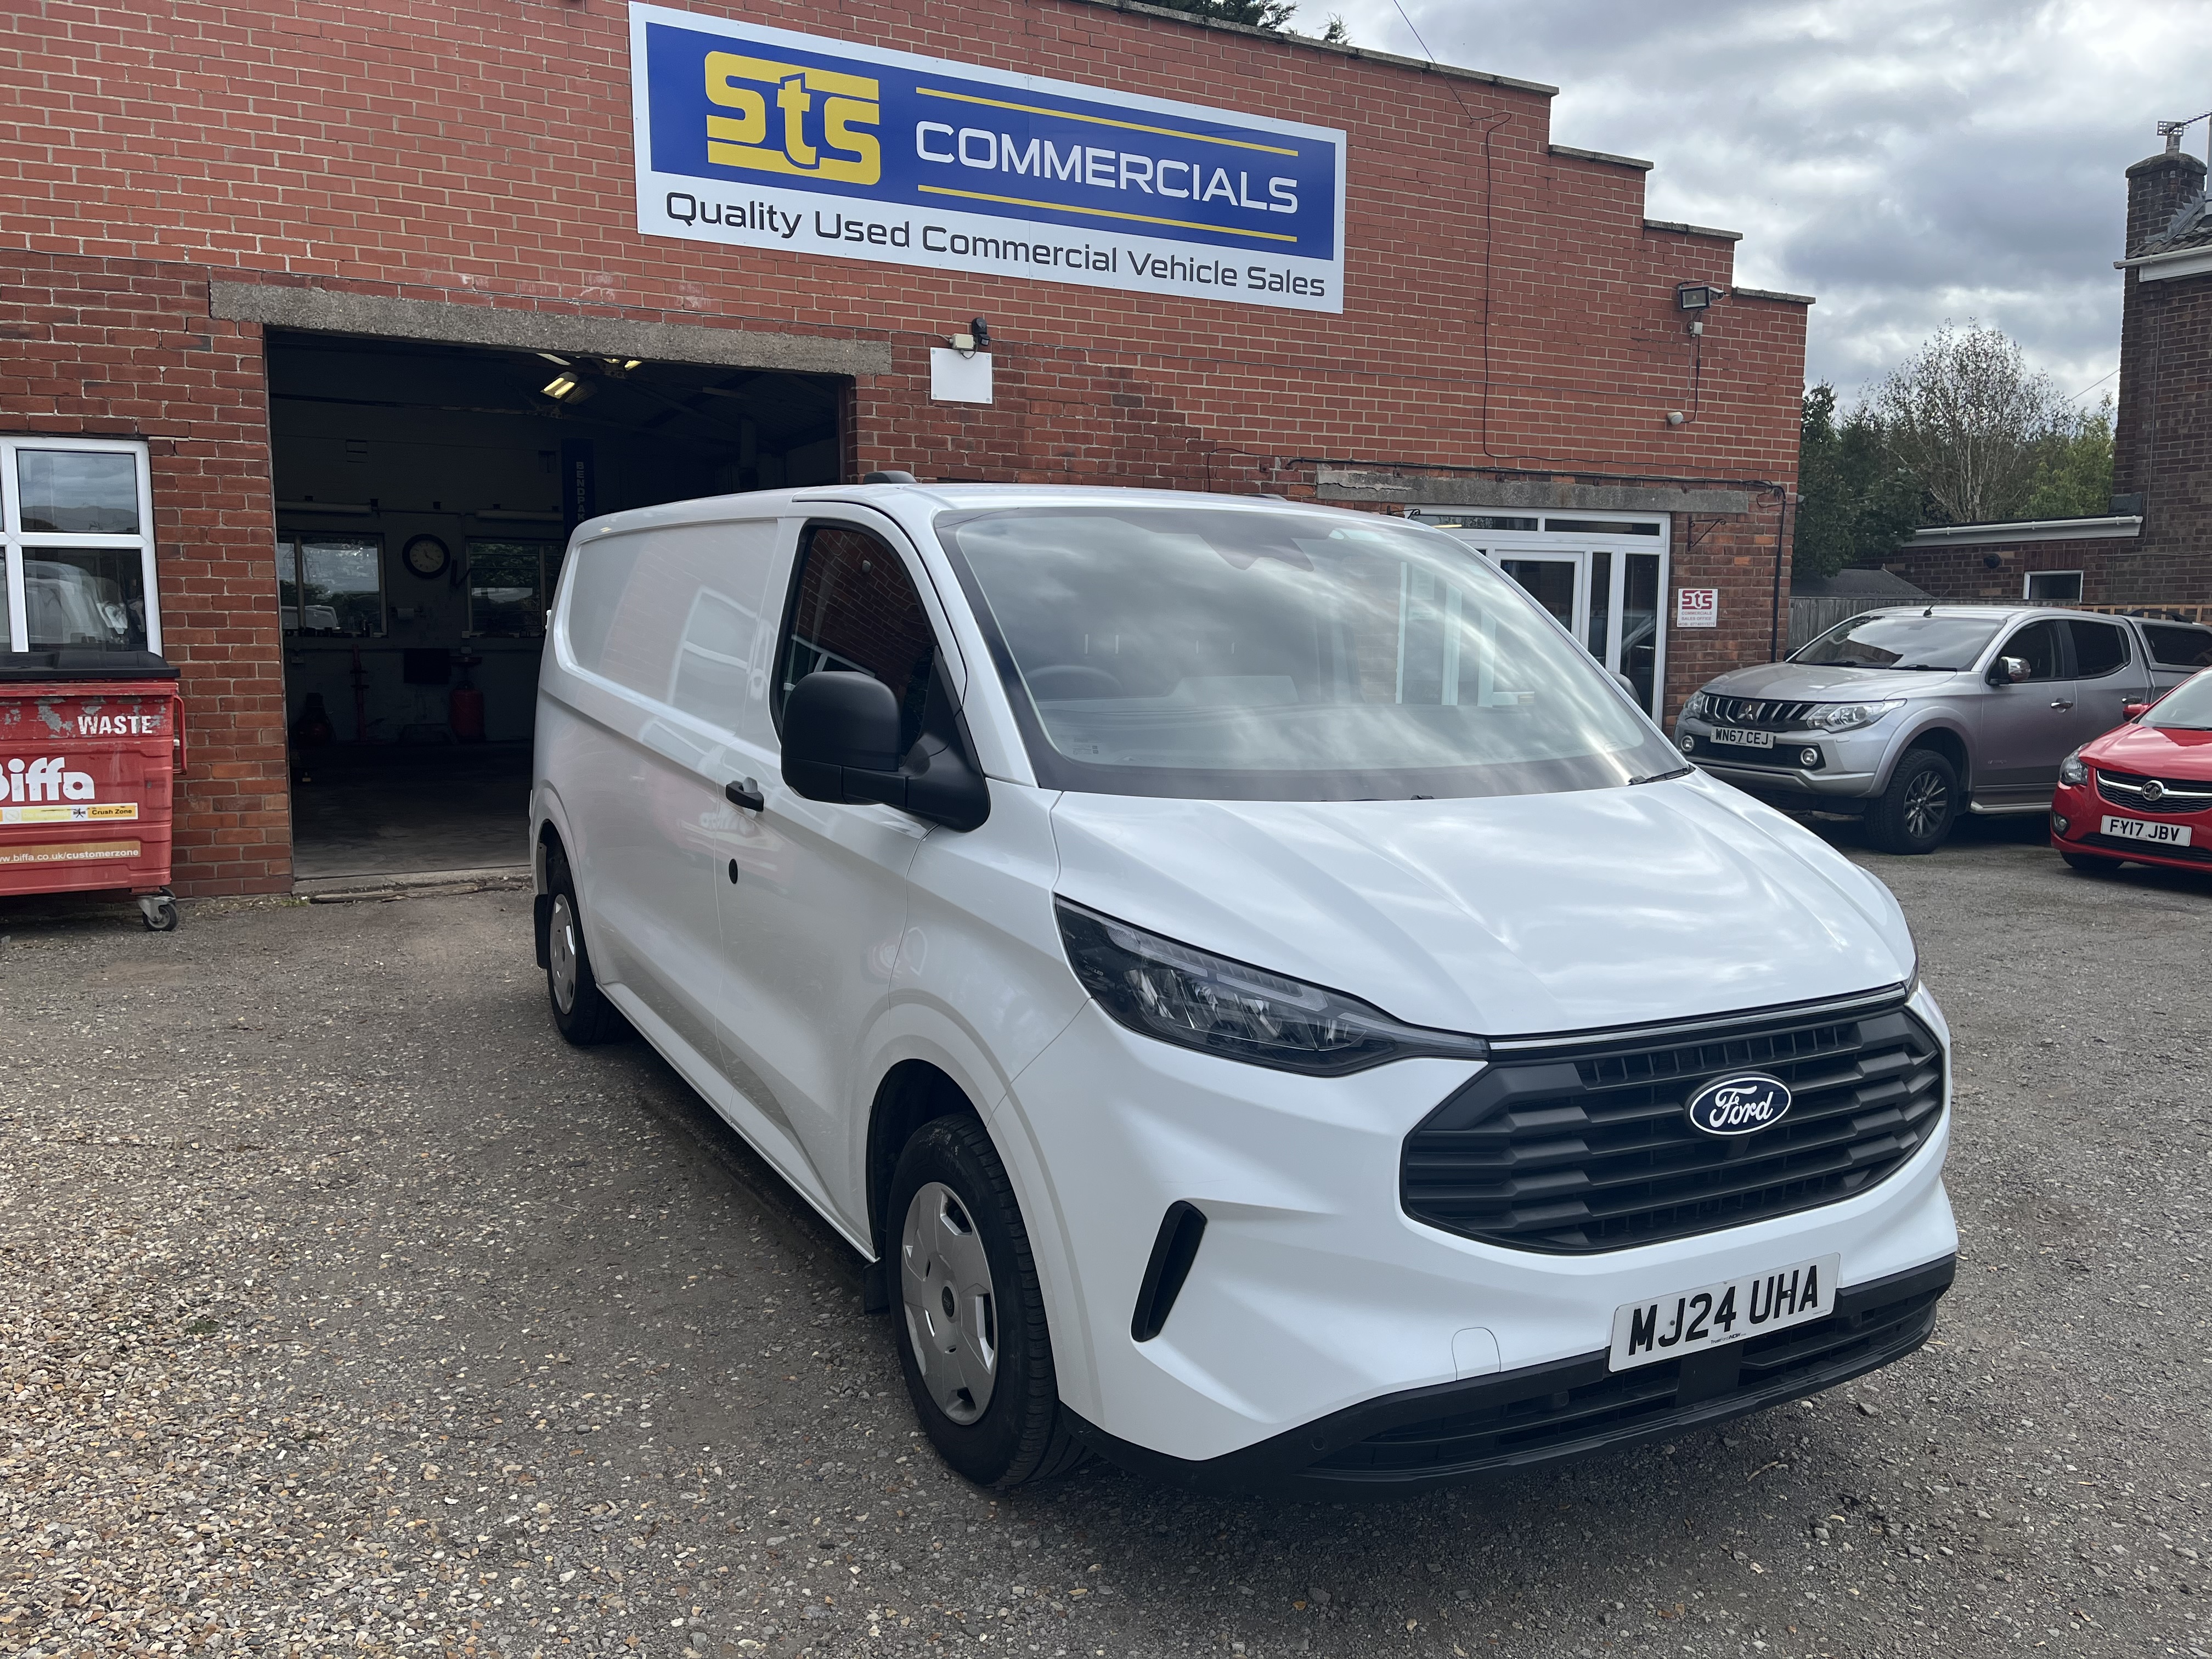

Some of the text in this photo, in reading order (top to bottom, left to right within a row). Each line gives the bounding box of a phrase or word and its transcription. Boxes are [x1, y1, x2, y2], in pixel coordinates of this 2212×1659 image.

[916, 121, 1298, 214] COMMERCIALS
[667, 192, 1325, 297] Quality Used Commercial Vehicle Sales
[576, 461, 585, 521] BENDPAK
[77, 715, 153, 735] WASTE
[1716, 728, 1769, 745] WN67 CEJ
[2110, 819, 2180, 842] FY17 JBV
[1709, 1085, 1774, 1127] Ford
[1628, 1265, 1818, 1356] MJ24 UHA
